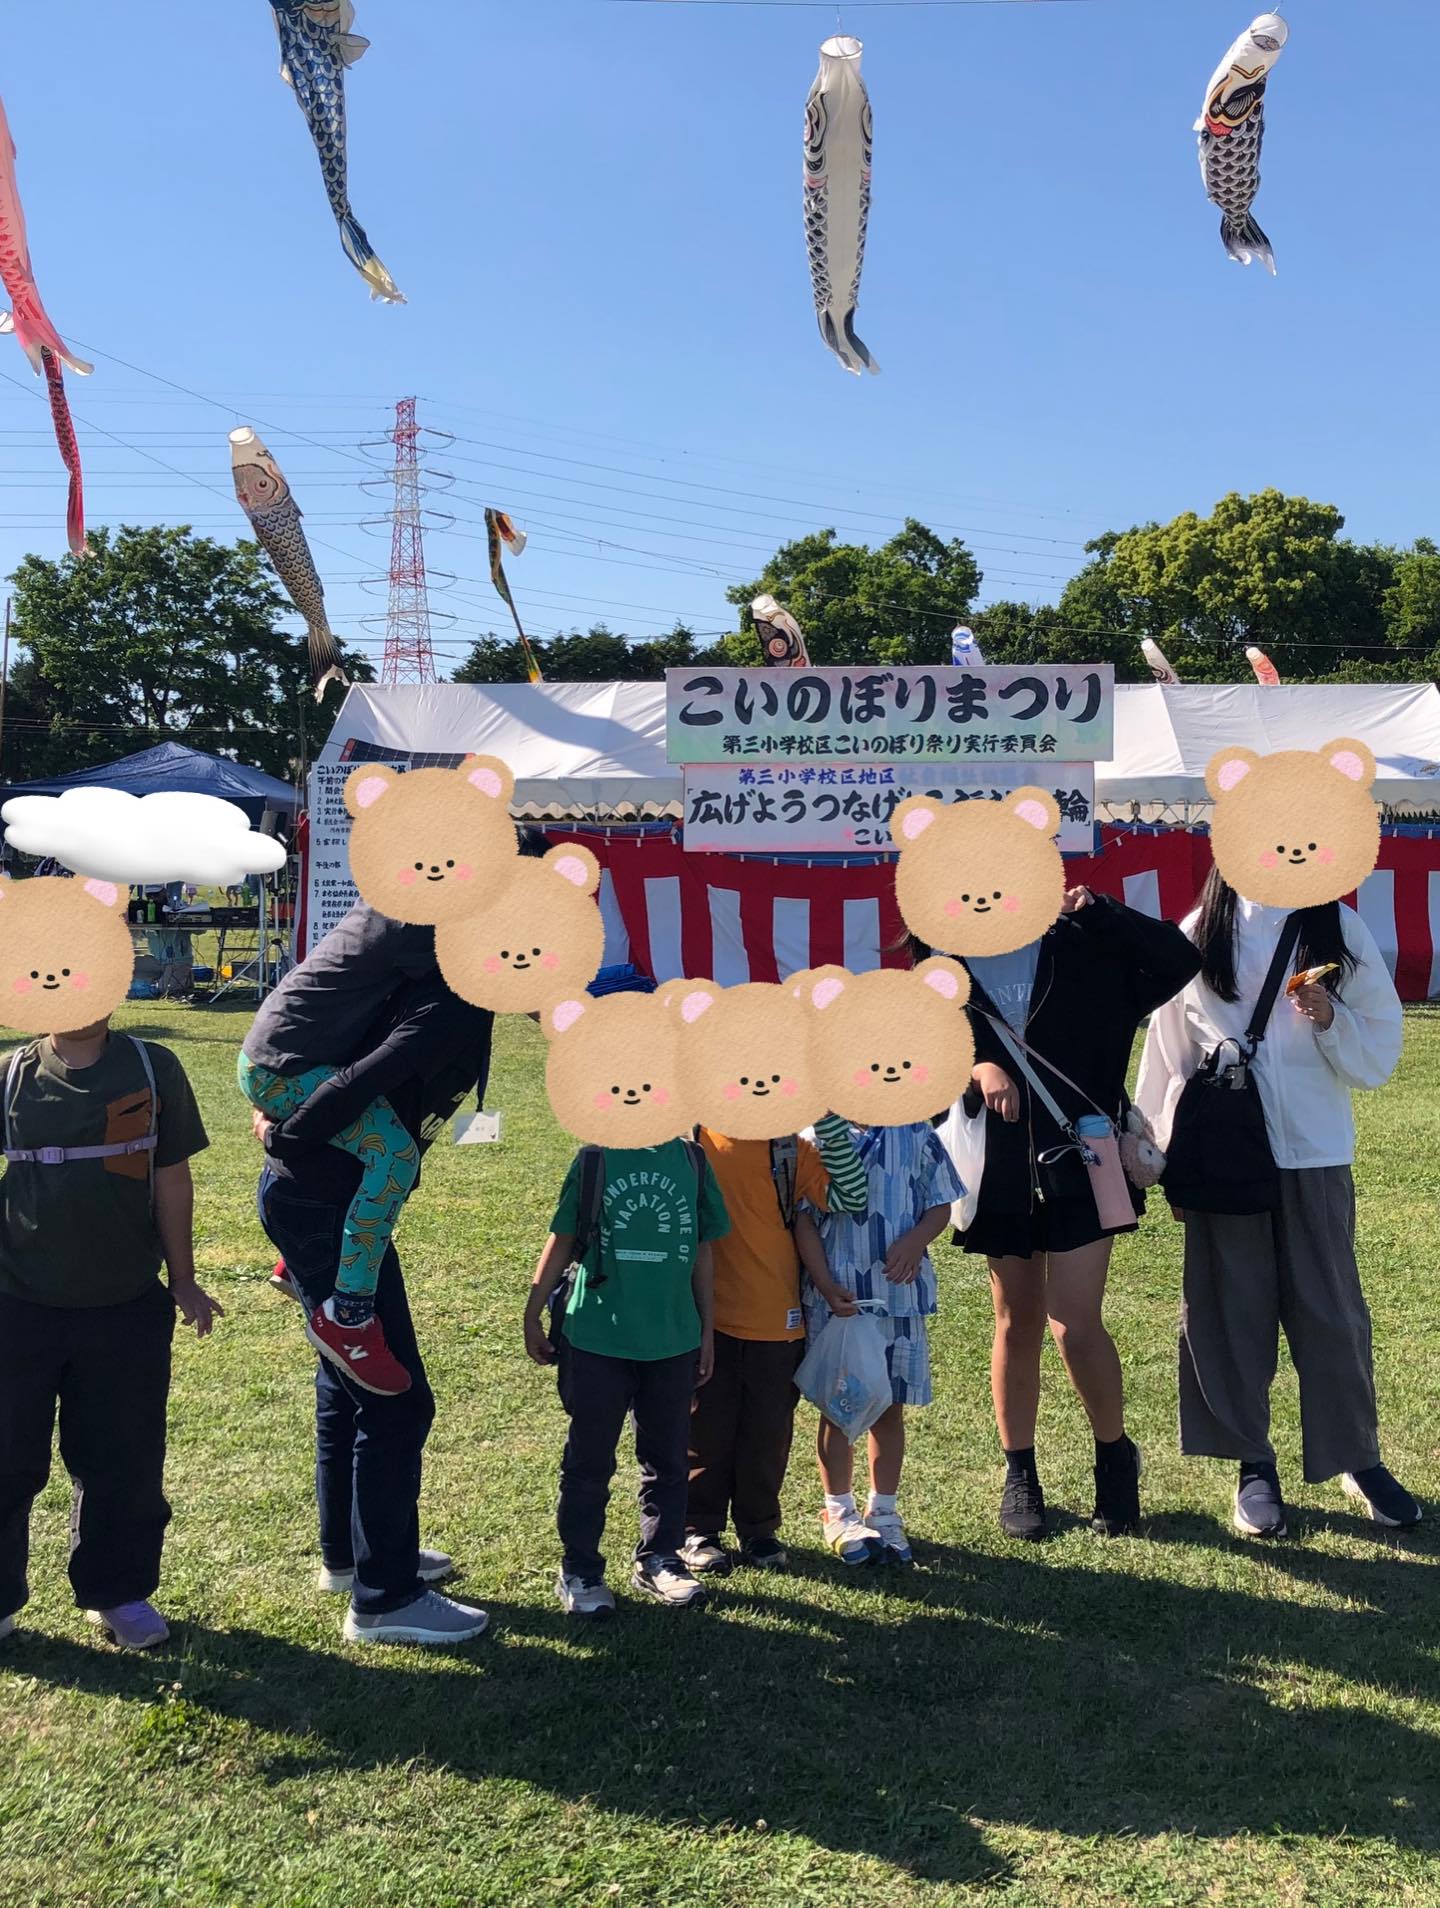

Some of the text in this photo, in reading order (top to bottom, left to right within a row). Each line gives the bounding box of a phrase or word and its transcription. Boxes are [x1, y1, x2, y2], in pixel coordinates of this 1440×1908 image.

[679, 672, 1102, 726] こいのぼりまつり
[722, 733, 1058, 755] 第三小学校区こいのぼり祭り実行委員会
[738, 767, 895, 786] 第三小学校区地区
[603, 1171, 678, 1213] ONDERFUL
[614, 1193, 672, 1234] VACATION
[675, 1195, 693, 1235] TIME
[678, 1244, 690, 1264] OF
